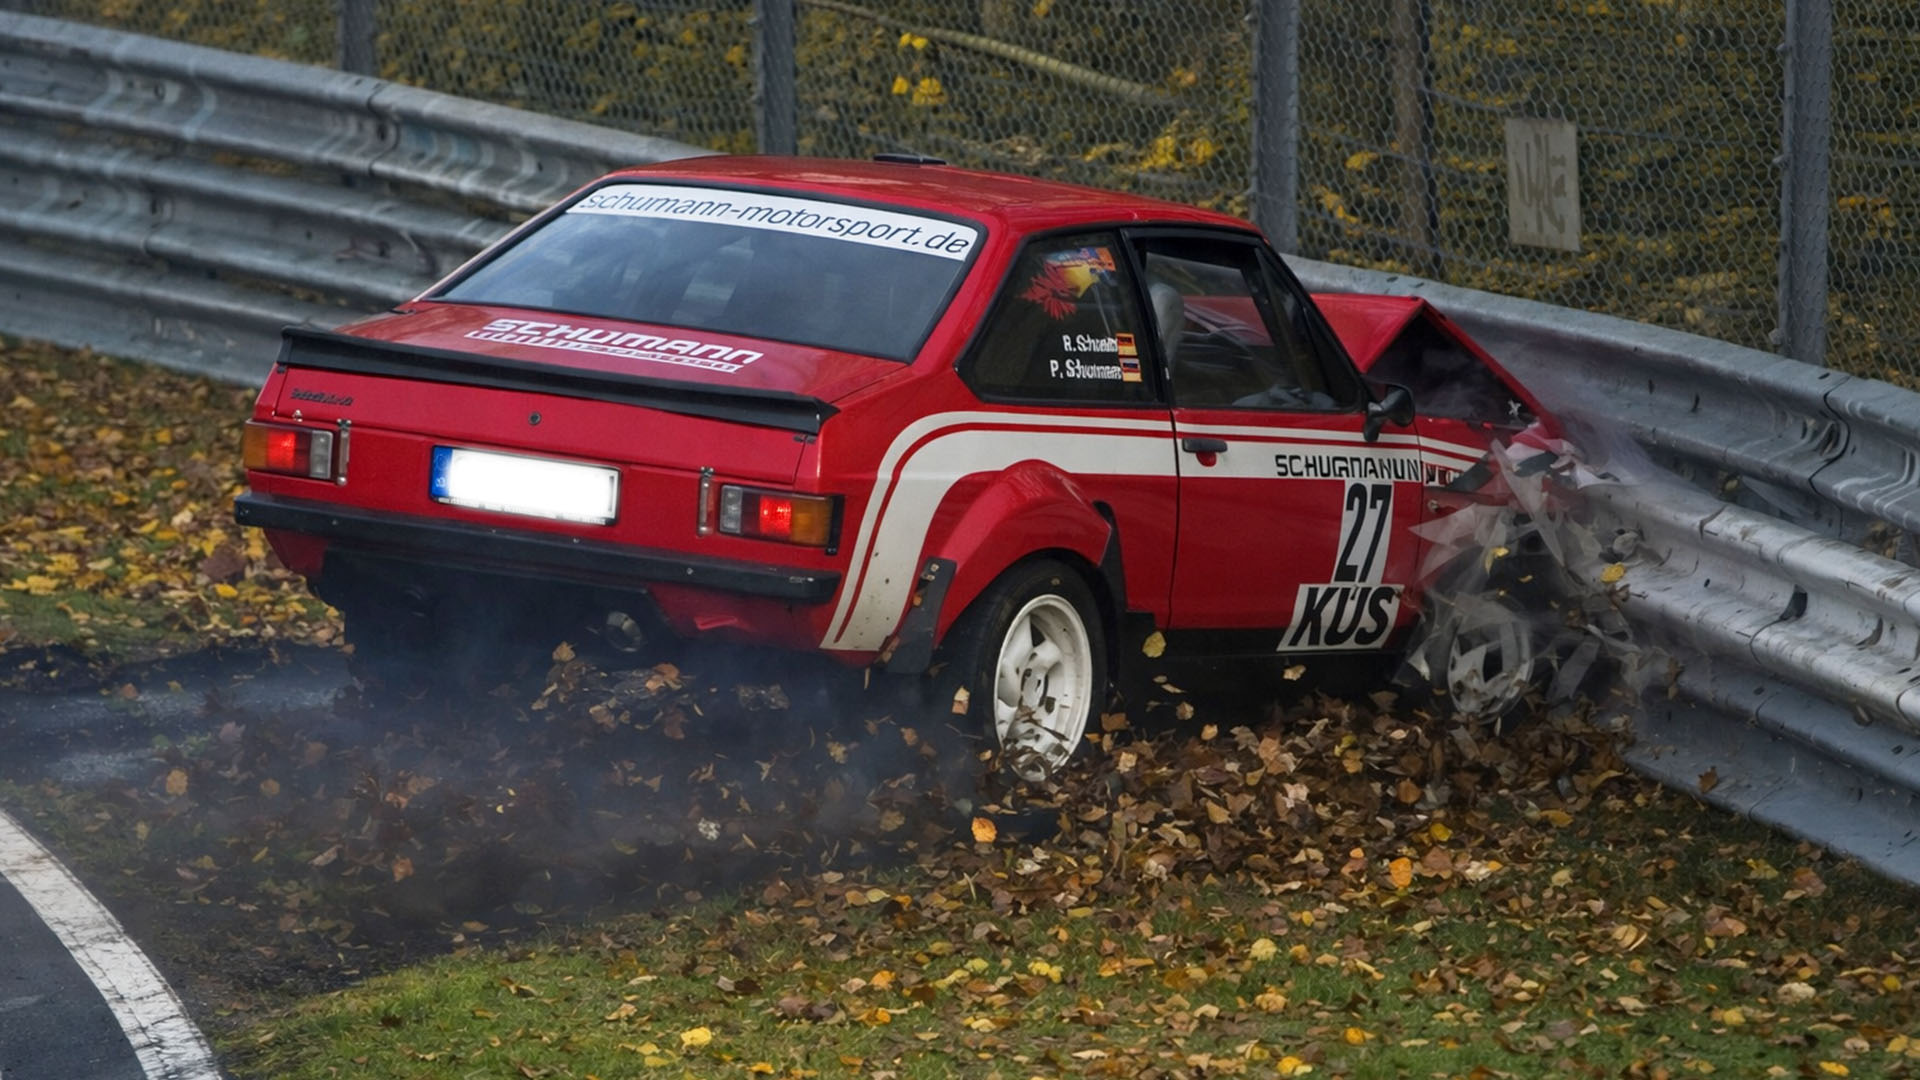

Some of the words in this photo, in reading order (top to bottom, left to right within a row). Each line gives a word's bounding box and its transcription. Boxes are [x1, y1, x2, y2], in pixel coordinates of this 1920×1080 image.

[580, 192, 970, 255] schumann-motorsport.de
[482, 318, 765, 365] SCHUMANN
[1333, 482, 1393, 583] 27
